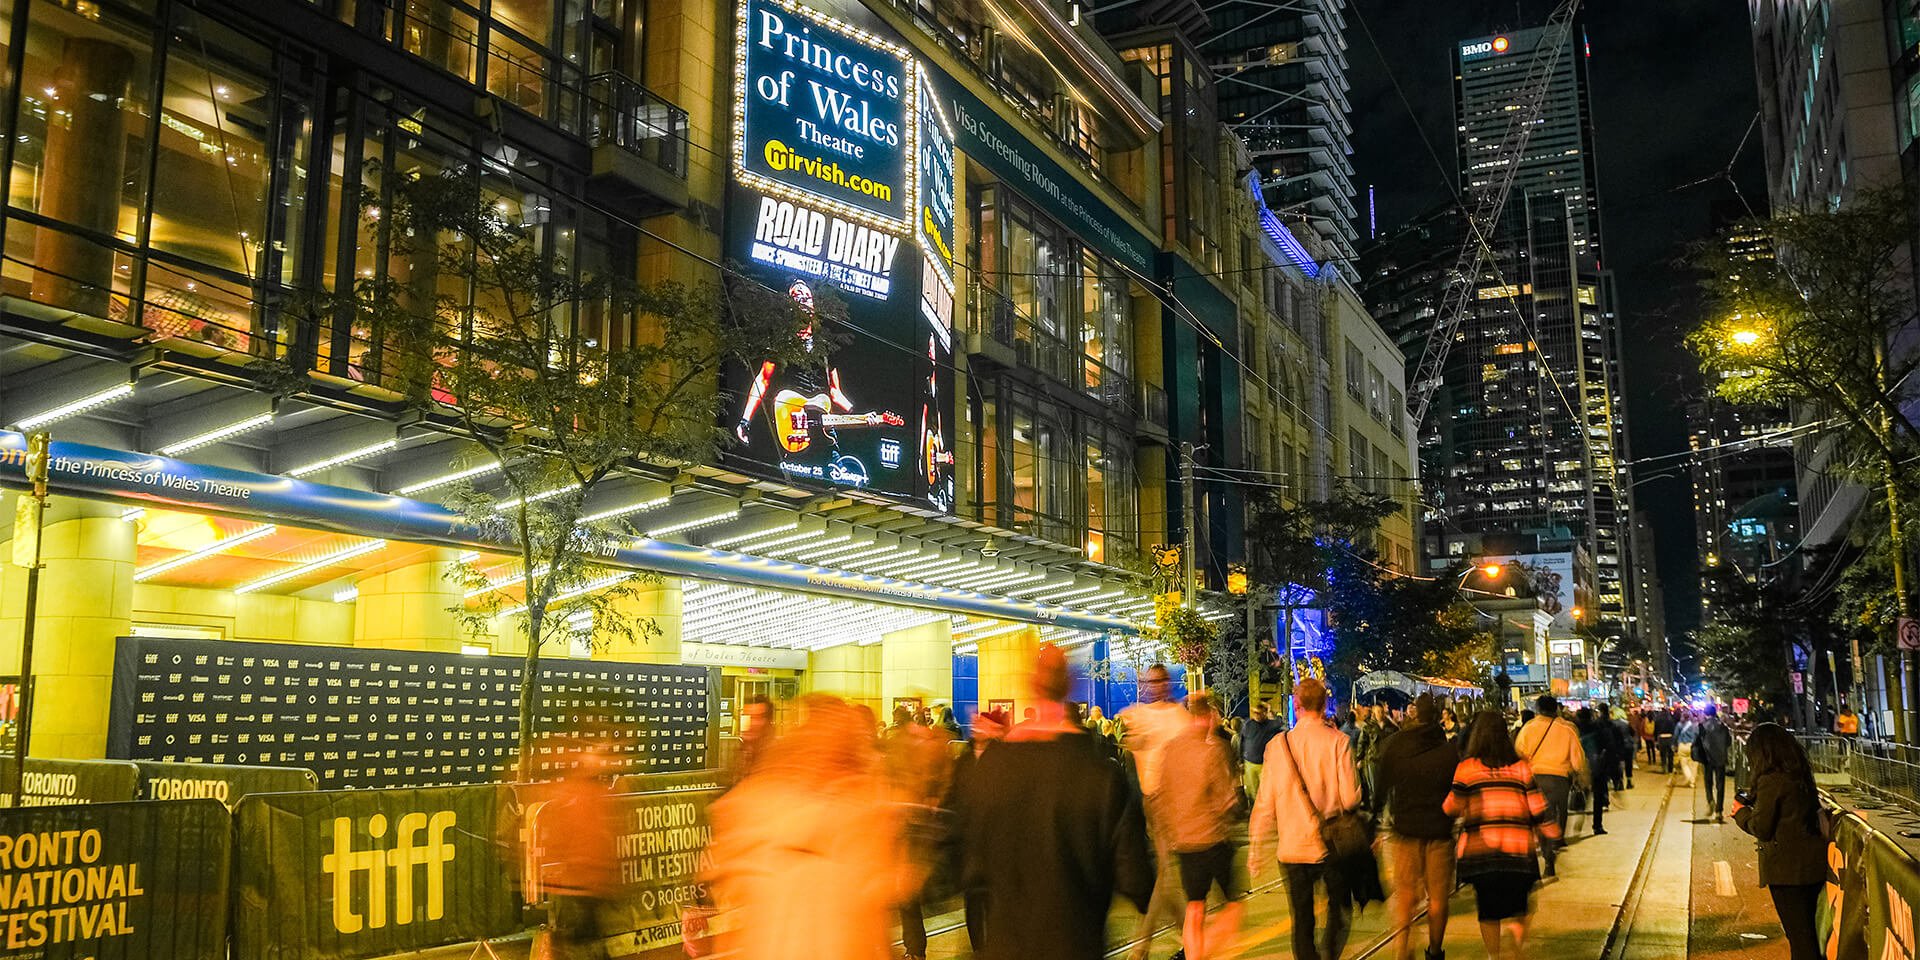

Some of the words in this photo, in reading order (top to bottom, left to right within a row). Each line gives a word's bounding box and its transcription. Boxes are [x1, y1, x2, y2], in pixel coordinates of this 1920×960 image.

[758, 9, 899, 99] Princess
[1462, 42, 1492, 56] BMO
[757, 70, 795, 107] of
[808, 79, 899, 147] Wales
[795, 118, 864, 159] Theatre
[764, 139, 891, 202] mirvish.com
[952, 100, 977, 137] Visa
[978, 120, 1032, 182] Screening
[1031, 163, 1060, 200] Room
[1060, 193, 1069, 205] at
[1067, 197, 1080, 217] the
[1078, 205, 1104, 235] Princess
[1102, 226, 1112, 239] of
[1110, 230, 1127, 254] Wales
[755, 196, 826, 257] ROAD
[827, 217, 900, 277] DIARY
[880, 443, 900, 463] tiff
[780, 461, 812, 475] October
[812, 465, 823, 476] 25
[55, 457, 81, 474] the
[83, 463, 143, 483] Princess
[143, 472, 162, 486] of
[161, 473, 200, 492] Wales
[202, 479, 250, 499] Theatre
[145, 654, 158, 663] tiff
[196, 656, 208, 664] tiff
[263, 659, 279, 667] VISA
[169, 674, 182, 683] tiff
[219, 675, 230, 684] tiff
[142, 693, 155, 702] tiff
[192, 693, 205, 702] tiff
[166, 713, 179, 723] tiff
[188, 714, 206, 722] VISA
[216, 713, 228, 723] tiff
[138, 735, 151, 745] tiff
[189, 734, 201, 744] tiff
[238, 734, 250, 743] tiff
[257, 734, 275, 742] VISA
[213, 754, 226, 763] tiff
[323, 752, 338, 760] VISA
[149, 778, 229, 800] TORONTO
[635, 802, 696, 831] TORONTO
[616, 824, 718, 858] INTERNATIONAL
[323, 810, 457, 934] tiff
[621, 859, 653, 885] FILM
[657, 850, 719, 880] FESTIVAL
[658, 883, 707, 907] ROGERS
